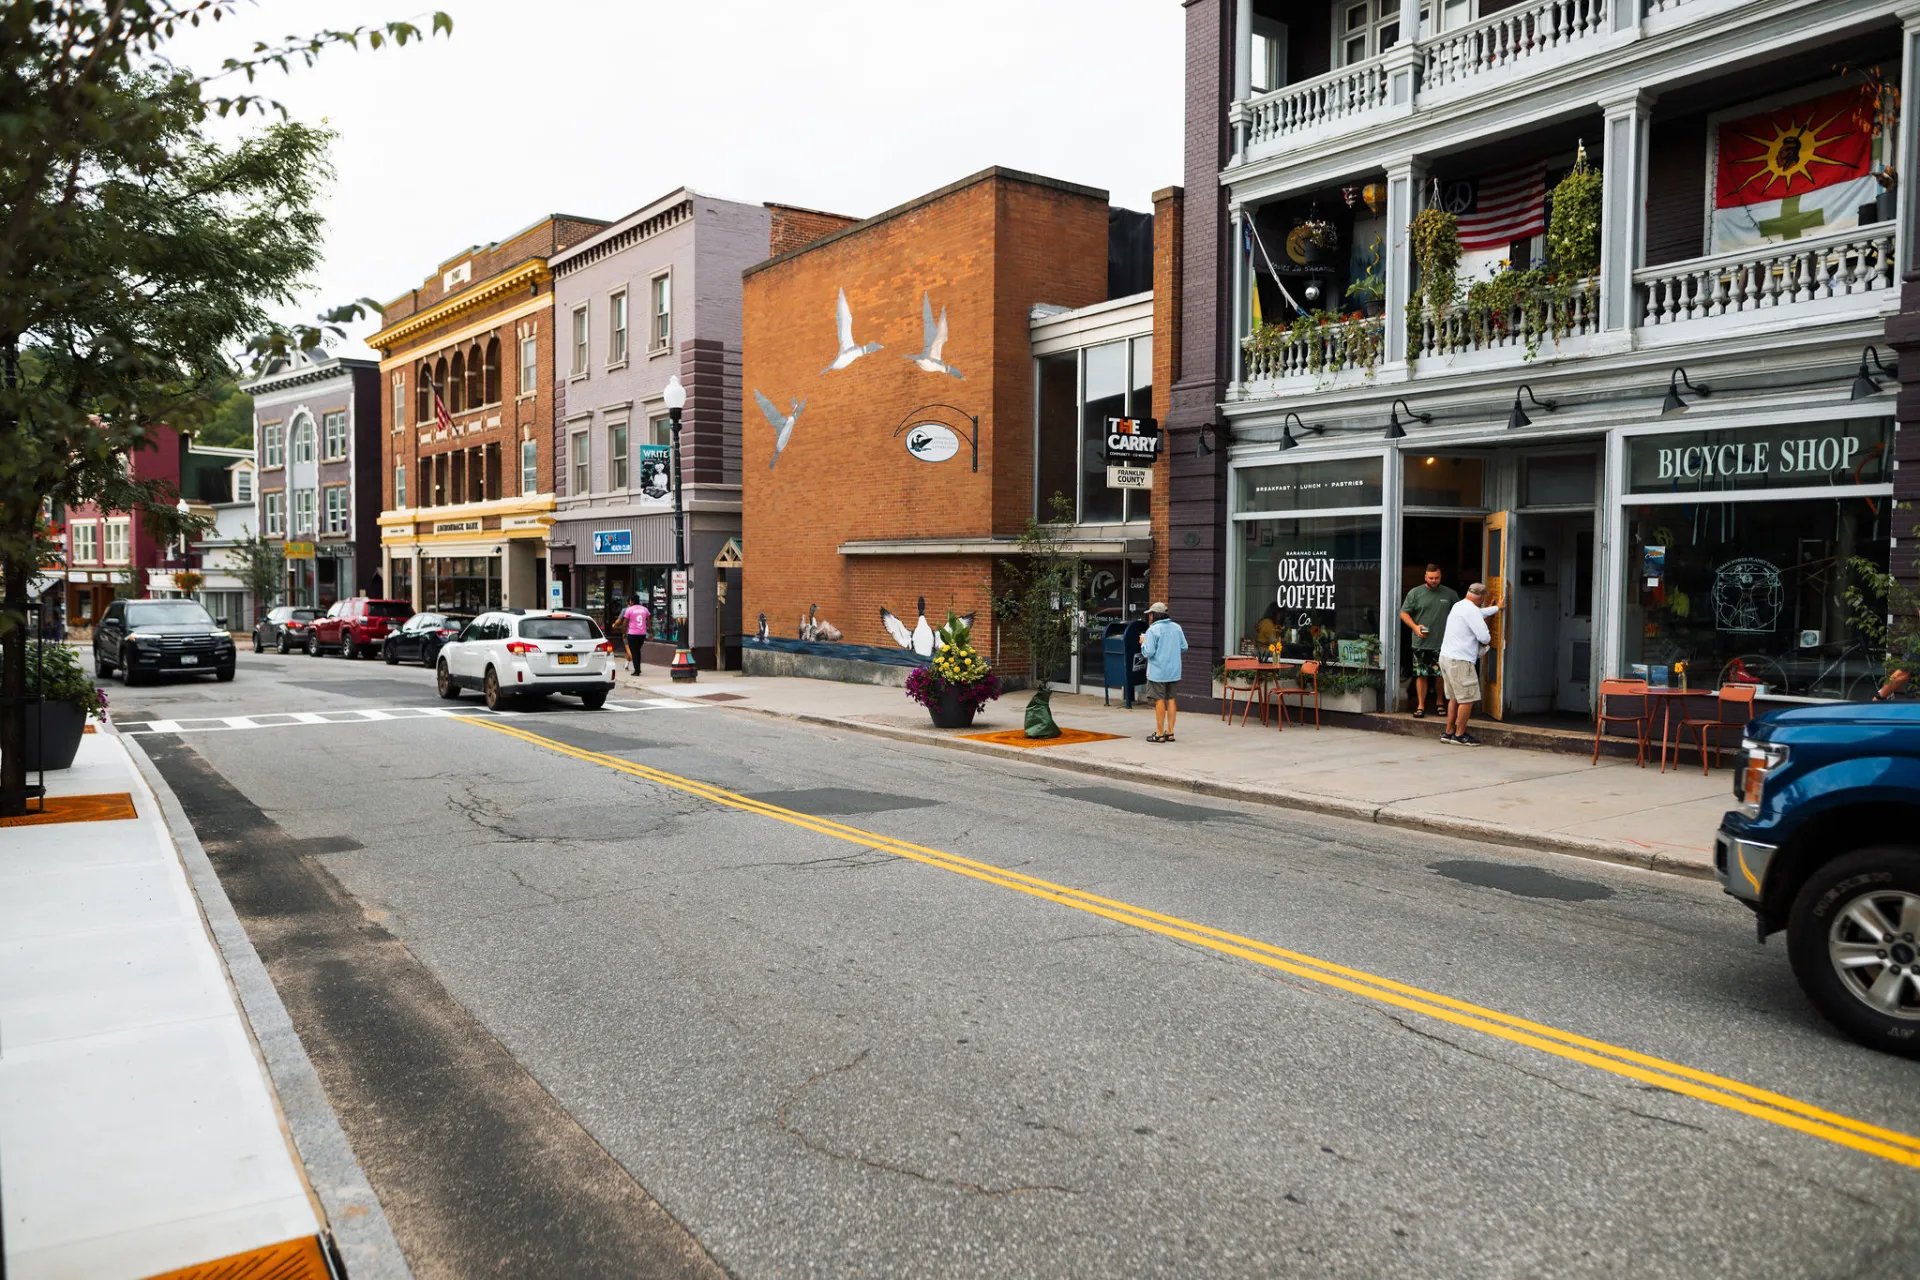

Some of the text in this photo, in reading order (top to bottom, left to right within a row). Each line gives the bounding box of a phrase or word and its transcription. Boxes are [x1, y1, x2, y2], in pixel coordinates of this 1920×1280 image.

[1108, 417, 1141, 435] THE
[1107, 434, 1158, 452] CARRY
[643, 450, 669, 458] WRITE
[1657, 436, 1860, 479] BICYCLE SHOP
[1117, 469, 1146, 477] FRANKLIN
[1117, 475, 1145, 484] COUNTY
[1331, 480, 1364, 488] PASTRIES
[1278, 558, 1335, 582] ORIGIN
[1276, 584, 1336, 611] COFFEE
[636, 614, 643, 627] 9
[1297, 612, 1313, 627] Co.
